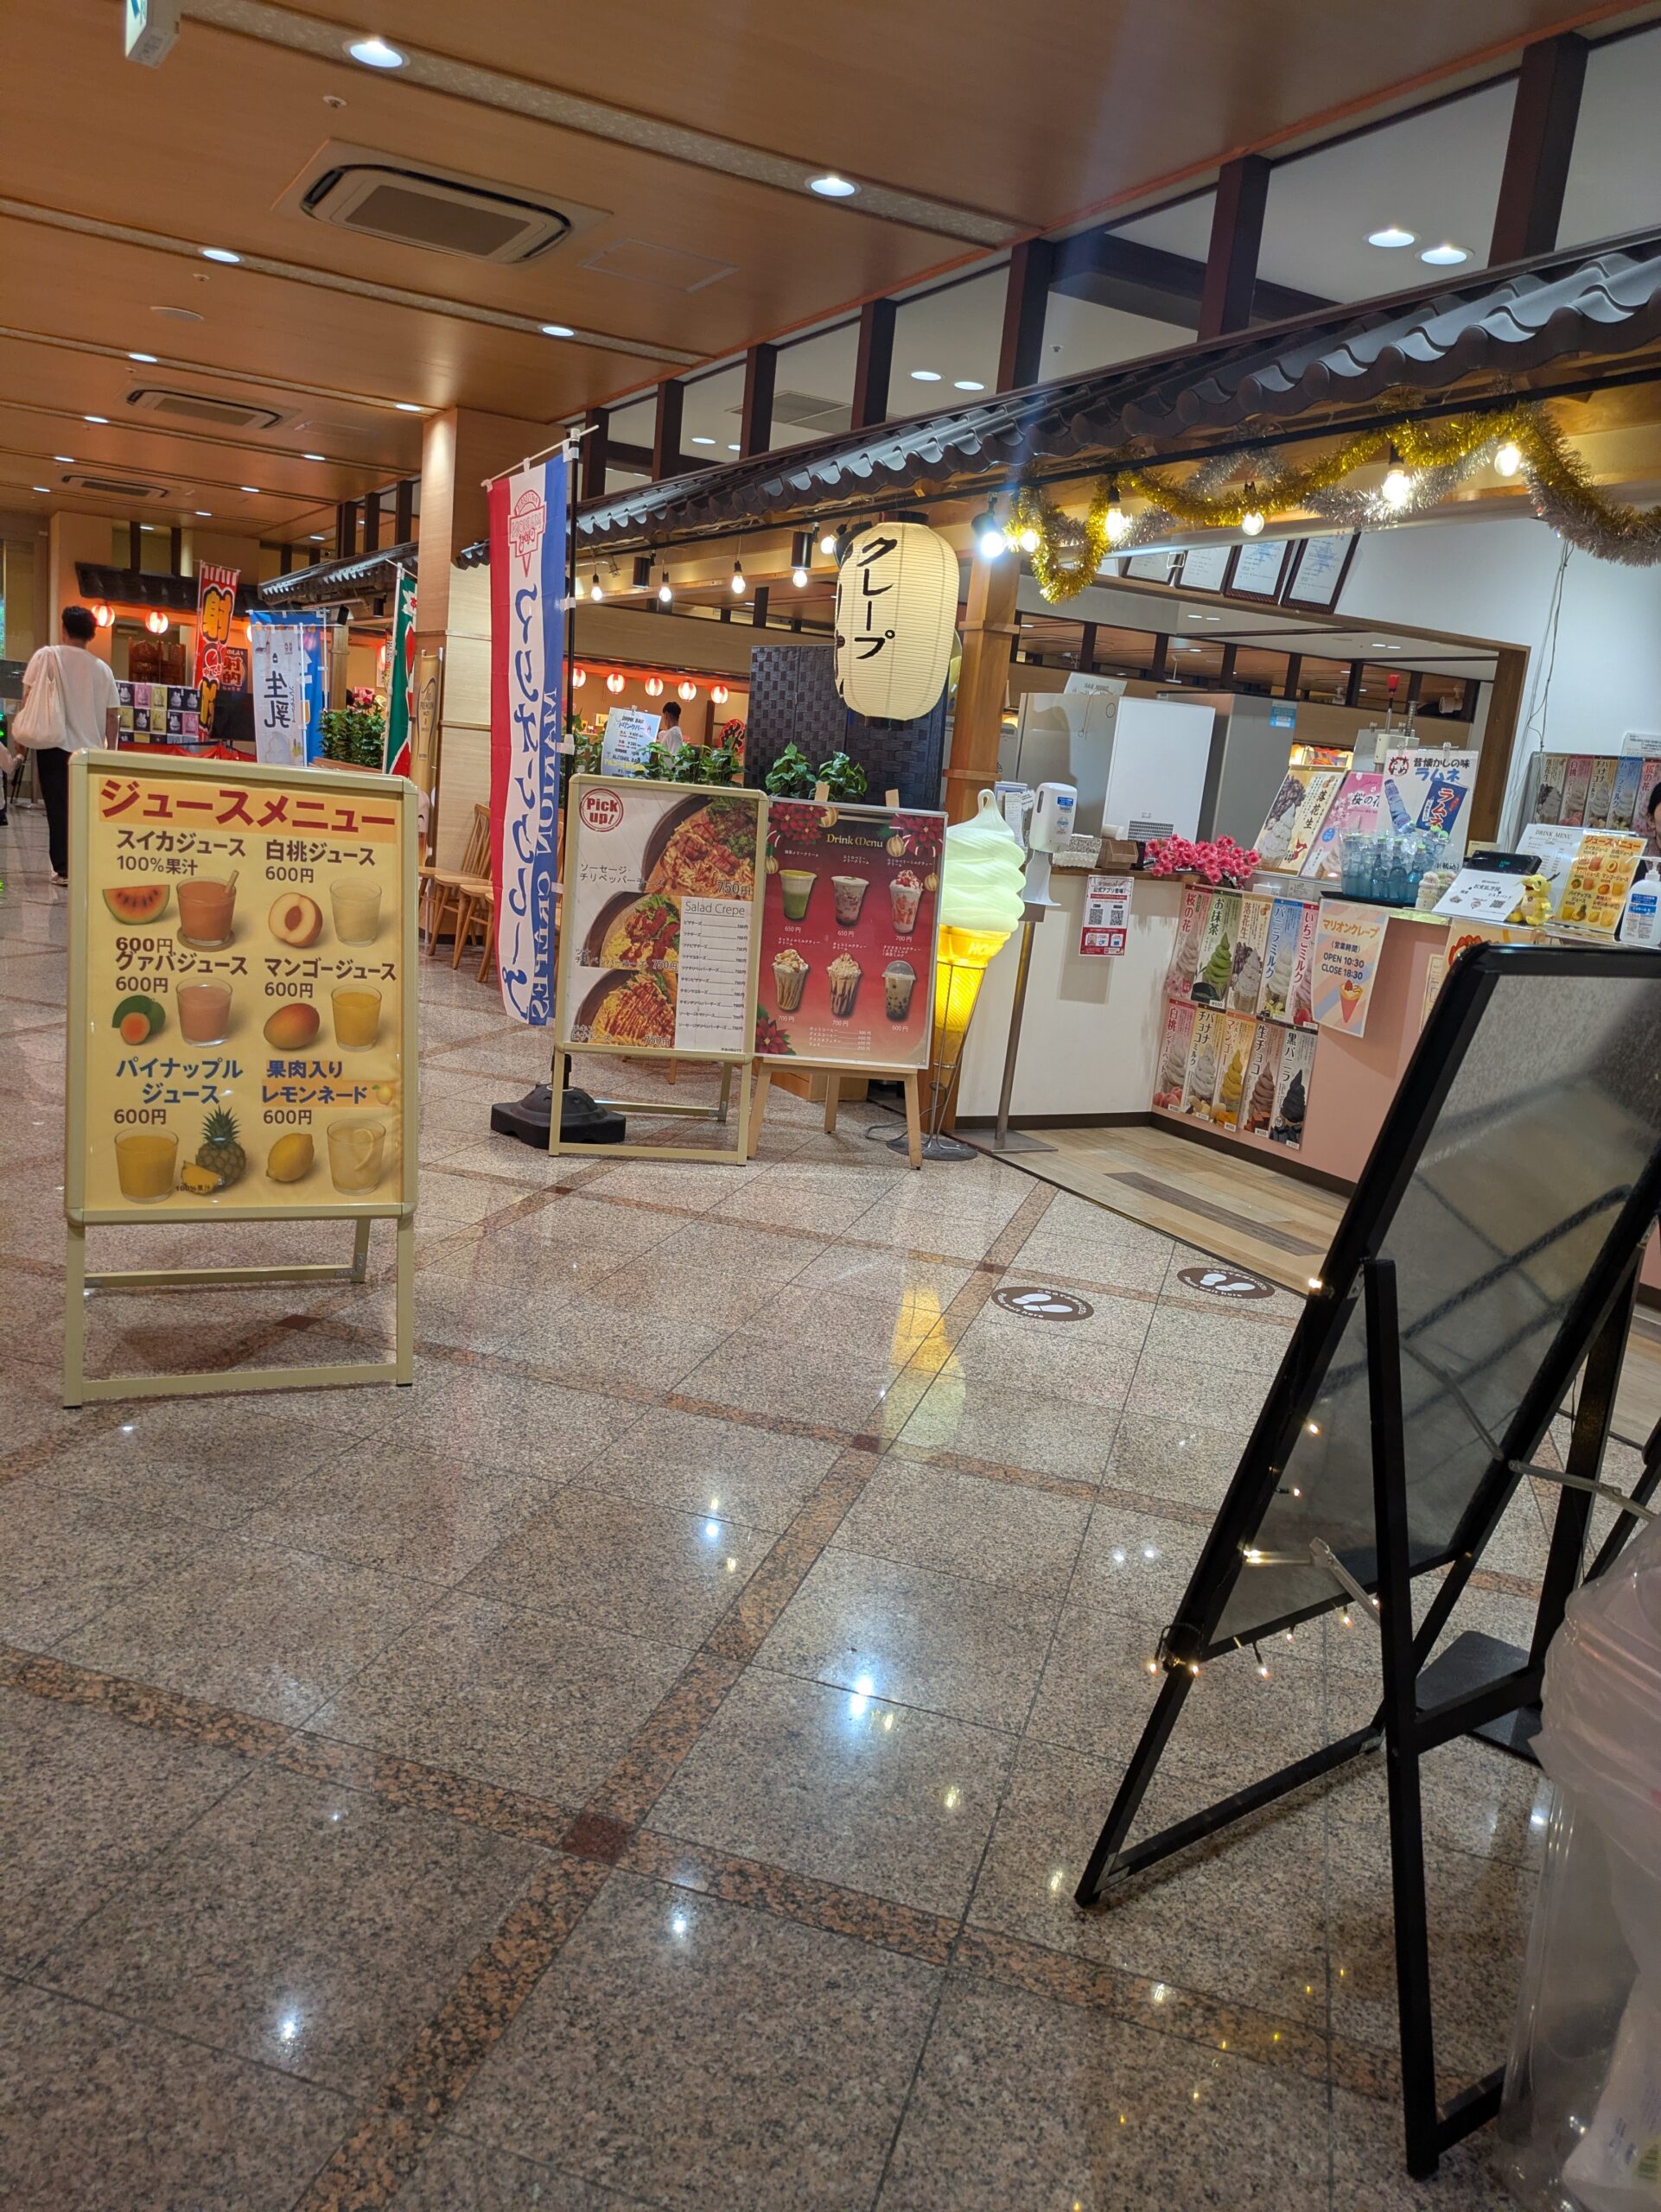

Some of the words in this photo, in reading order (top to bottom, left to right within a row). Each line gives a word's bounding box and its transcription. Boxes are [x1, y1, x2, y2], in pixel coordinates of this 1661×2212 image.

[855, 537, 898, 659] クレープ
[222, 657, 242, 687] 射的
[618, 721, 646, 732] ドリンクバー
[1413, 758, 1471, 769] 昔懐かしの味
[1415, 767, 1461, 783] ラムネ
[1641, 763, 1655, 792] 桜の花
[100, 779, 396, 834] ジュースメニュー
[586, 798, 619, 813] Pick
[1303, 790, 1327, 830] 落花生
[1427, 788, 1454, 830] ラムネ
[589, 811, 615, 826] up!
[826, 833, 854, 846] Drink
[855, 837, 884, 849] Menu
[1555, 830, 1573, 840] MENU
[117, 830, 246, 858] スイカジュース
[266, 840, 376, 867] 白桃ジュース
[117, 855, 198, 876] 100%果汁
[265, 866, 315, 884] 600円
[580, 873, 665, 887] チリペッパーチーズ
[718, 880, 752, 896] 750円
[685, 901, 712, 913] Salad
[714, 903, 746, 918] Crepe
[1181, 893, 1197, 933] 桜の花
[1208, 897, 1225, 937] お抹茶
[1239, 901, 1252, 939] 落花生
[784, 925, 802, 934] 650円
[837, 929, 855, 938] 650円
[895, 935, 913, 944] 700円
[1322, 918, 1380, 938] マリオンクレープ
[116, 937, 174, 954] 600円
[1264, 906, 1286, 979] バニラミルク
[1293, 912, 1314, 983] いちごミルク
[1331, 940, 1361, 954] (営業時間)
[115, 950, 248, 976] グァバジュース
[264, 957, 398, 982] マンゴージュース
[652, 959, 678, 970] 750円
[1321, 963, 1342, 976] CLOSE
[1344, 969, 1363, 981] 18:30
[1323, 952, 1342, 963] OPEN
[1344, 957, 1365, 969] 10:30
[115, 976, 169, 994] 600円
[264, 982, 314, 999] 600円
[778, 1014, 795, 1024] 700円
[831, 1019, 849, 1028] 700円
[891, 1024, 909, 1033] 600円
[1201, 1013, 1214, 1044] バナナ
[645, 1035, 671, 1046] 750円
[1190, 1011, 1206, 1065] チョコミルク
[1222, 1019, 1236, 1065] マンゴー
[1251, 1025, 1268, 1076] 生チョコ
[1281, 1033, 1297, 1082] 黒バニラ
[116, 1057, 243, 1079] パイナップル
[266, 1060, 344, 1079] 果肉入り
[141, 1084, 220, 1105] ジュース
[261, 1085, 368, 1105] レモンネード
[114, 1109, 167, 1125] 600円
[263, 1109, 313, 1126] 600円
